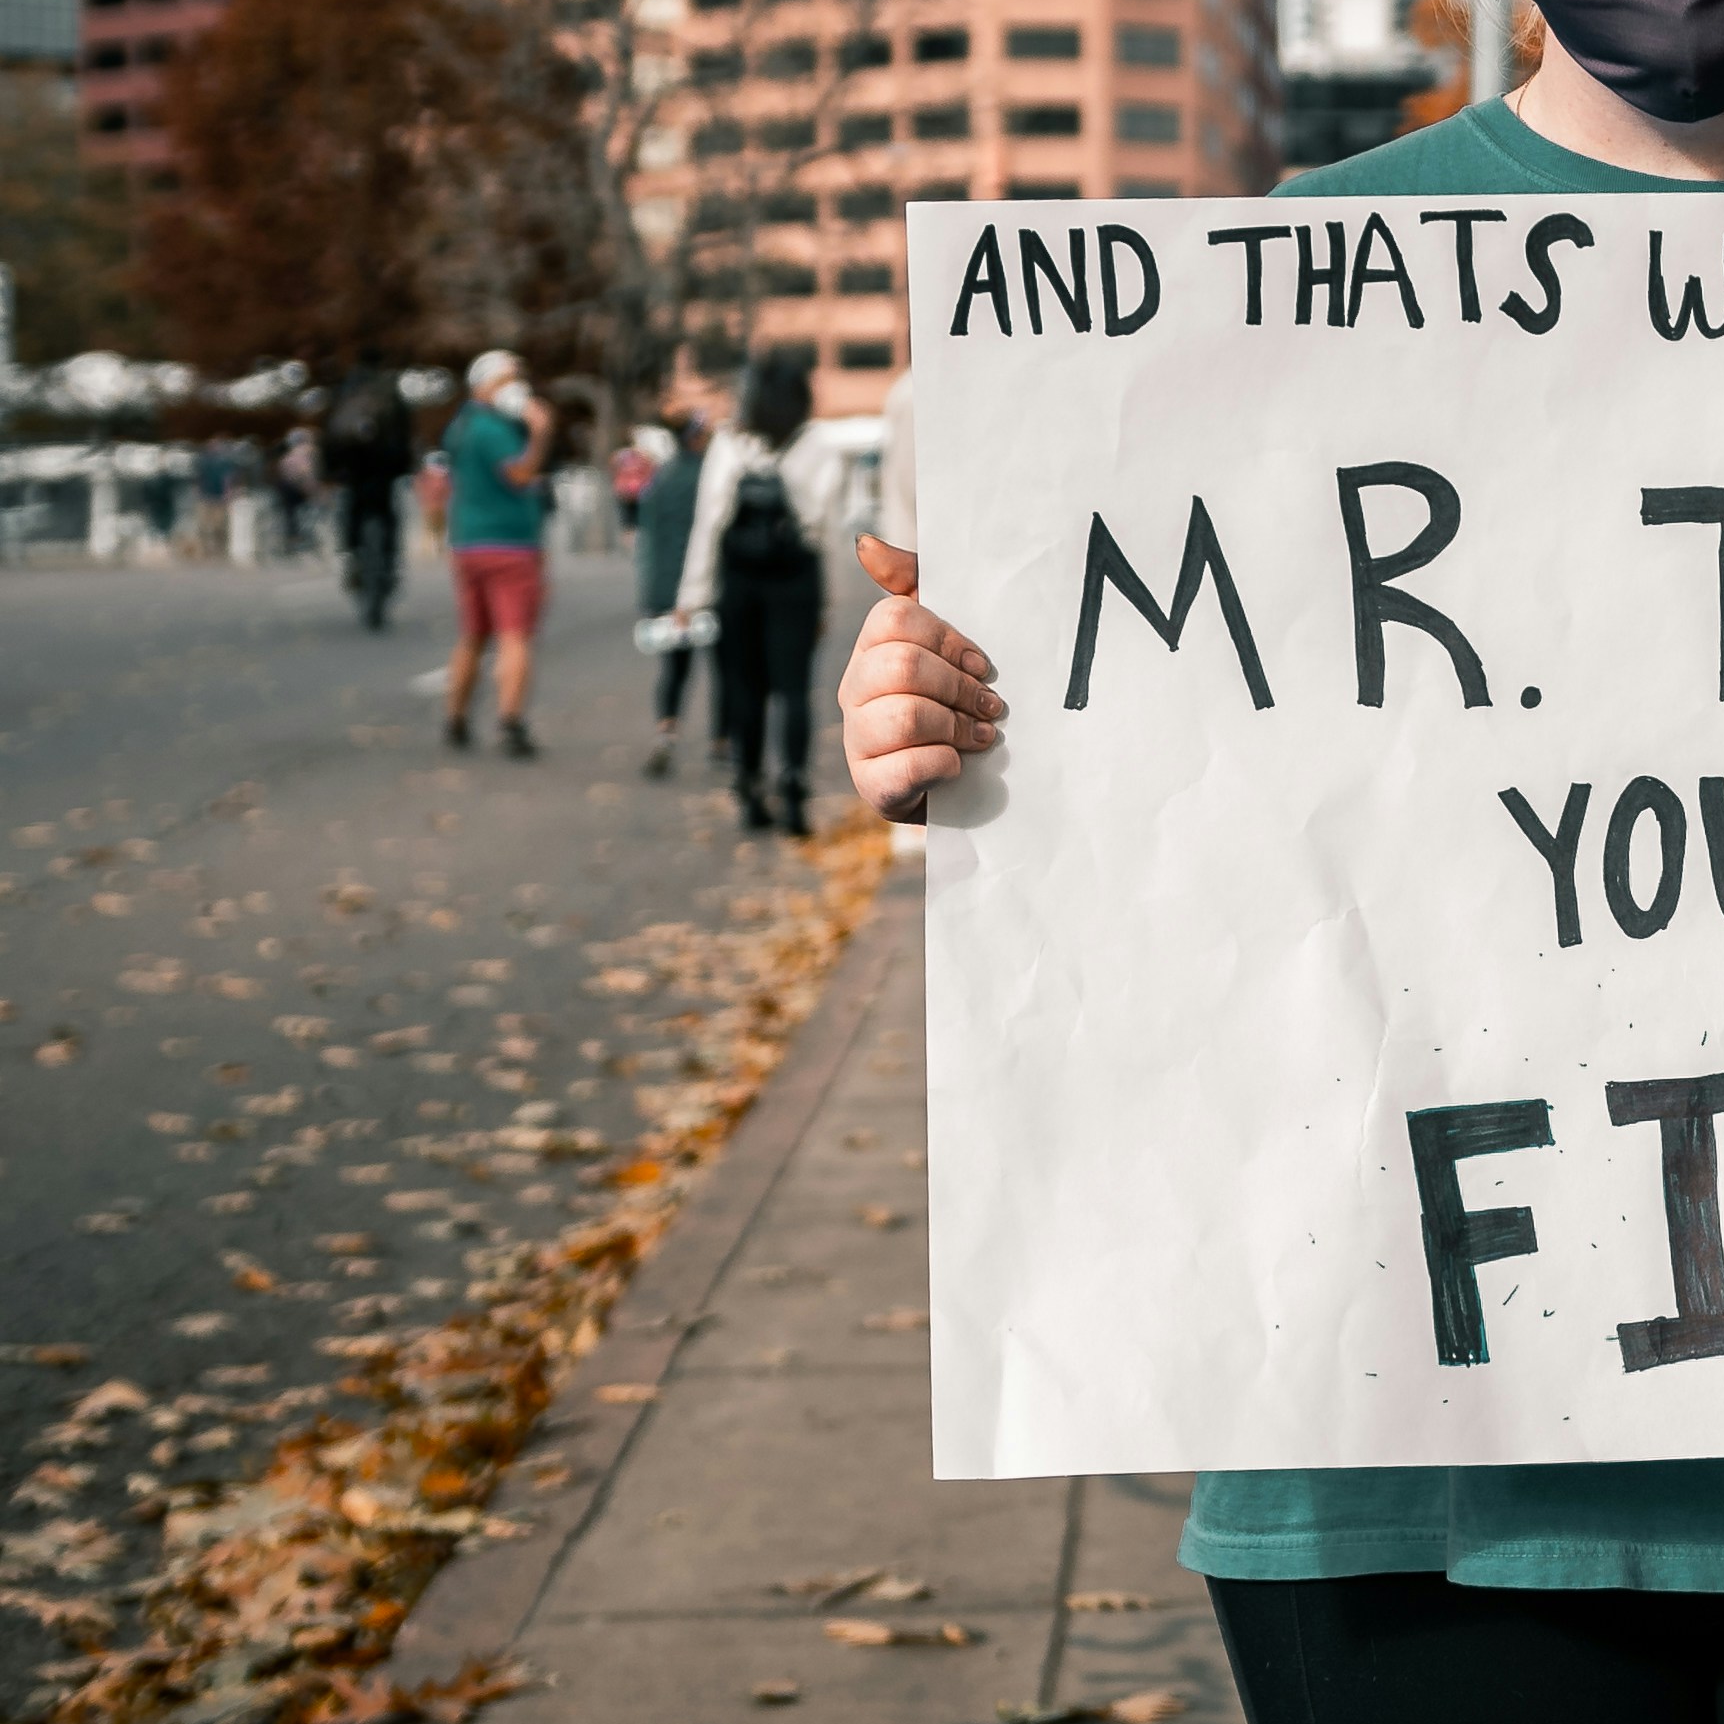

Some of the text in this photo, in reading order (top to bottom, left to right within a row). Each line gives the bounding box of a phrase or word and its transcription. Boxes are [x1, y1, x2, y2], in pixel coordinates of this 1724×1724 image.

[950, 223, 1160, 338] AND
[1207, 209, 1595, 336] THATS
[1063, 461, 1542, 711] MR.
